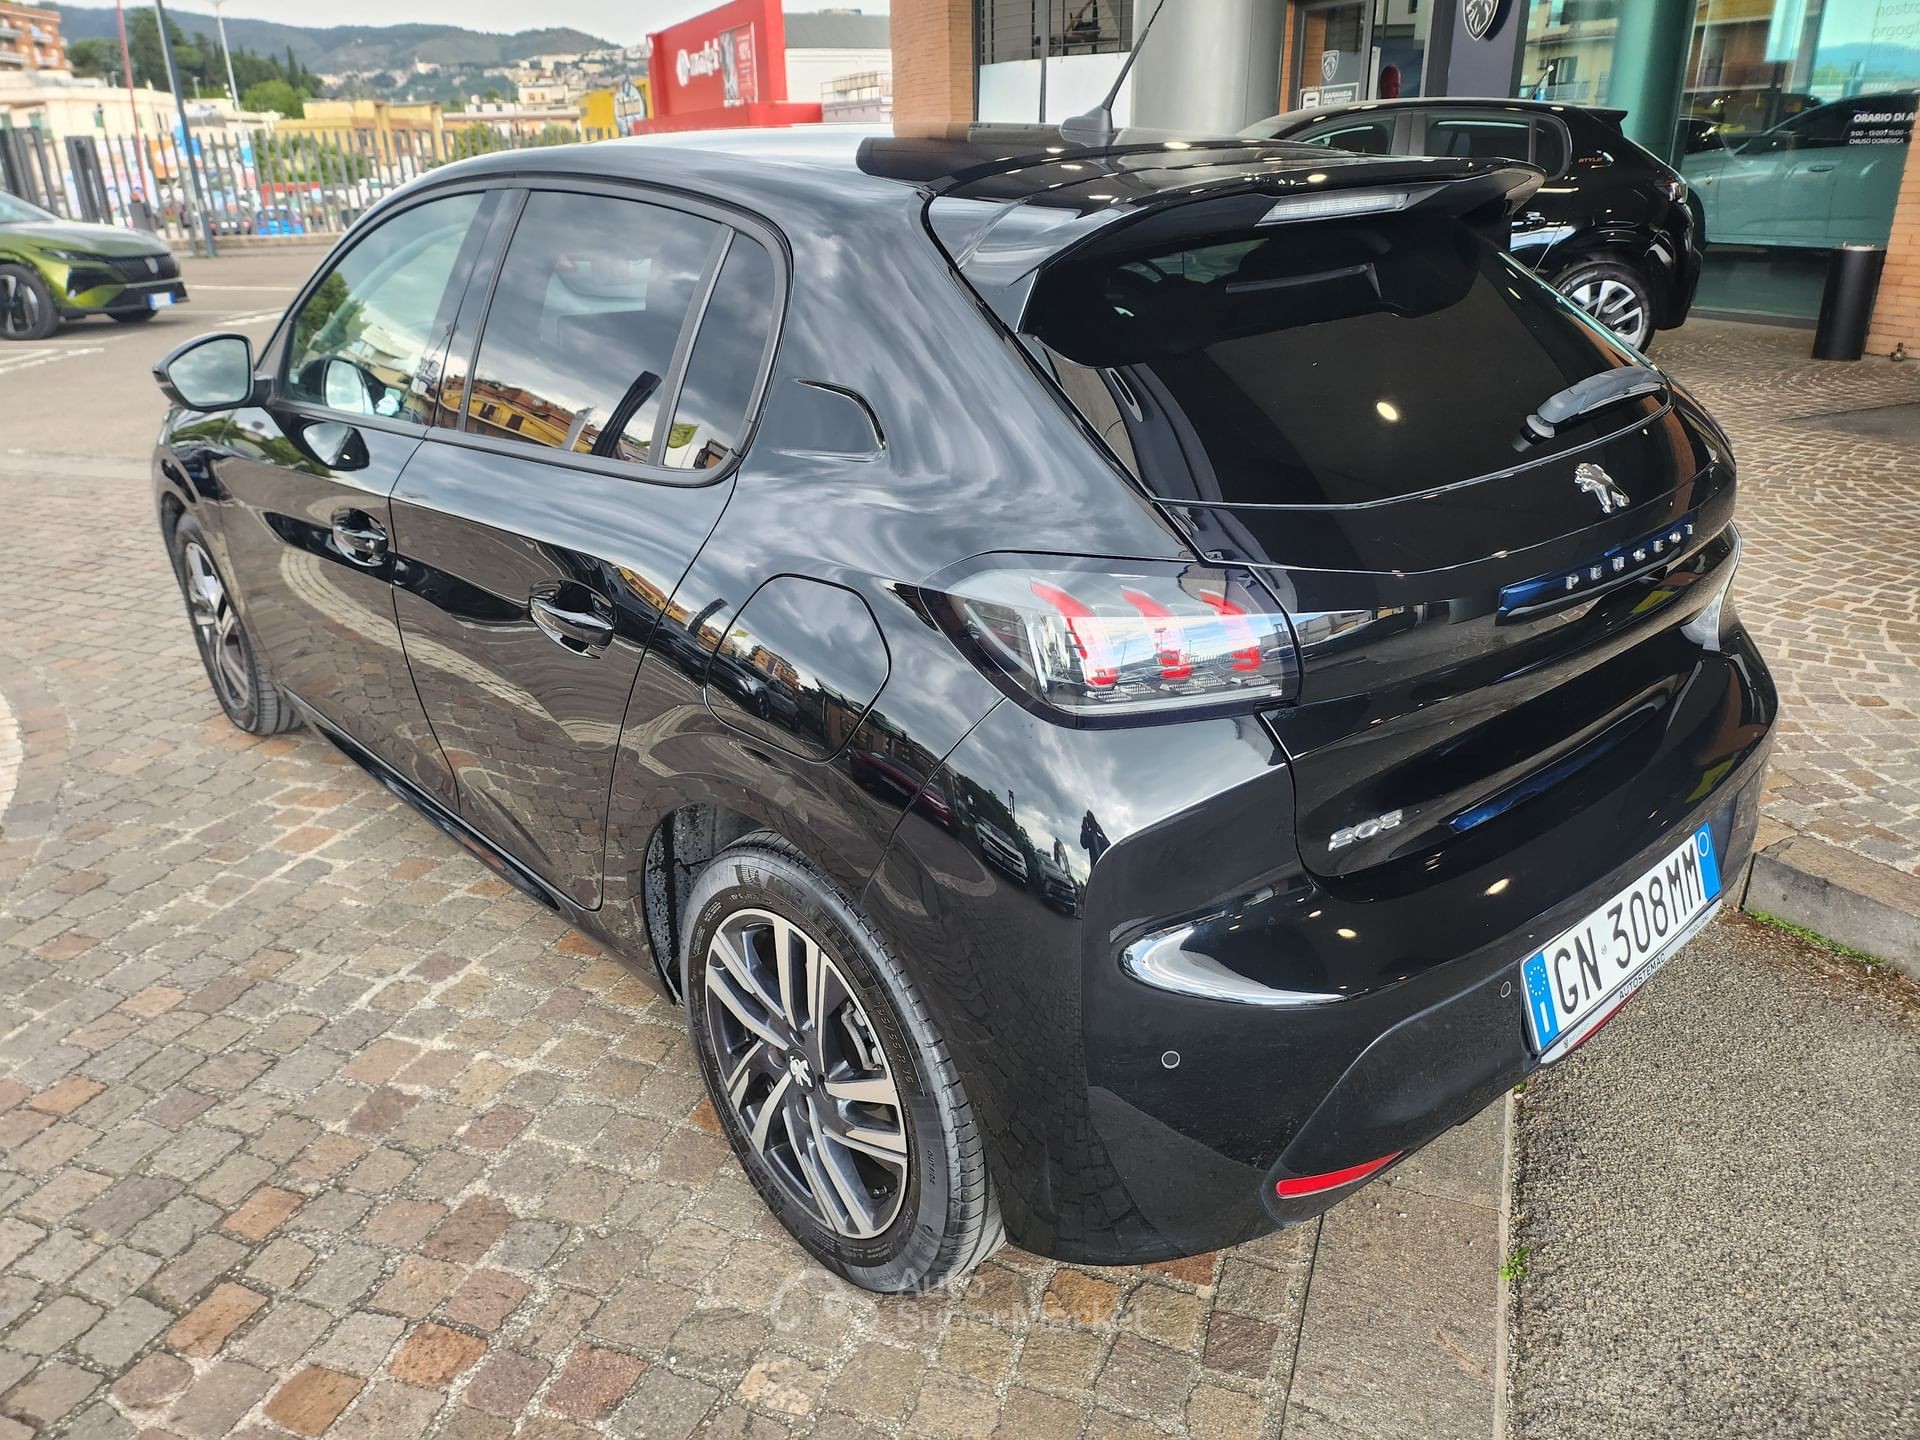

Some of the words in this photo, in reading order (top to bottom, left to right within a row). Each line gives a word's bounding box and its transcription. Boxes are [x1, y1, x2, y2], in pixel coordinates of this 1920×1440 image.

[1854, 113, 1892, 123] ORARIO
[1894, 112, 1906, 121] DI
[1327, 808, 1403, 852] 208
[1553, 926, 1603, 1015] GN
[1606, 842, 1702, 970] 308MM
[1619, 952, 1666, 1000] AUTOSTEMAC
